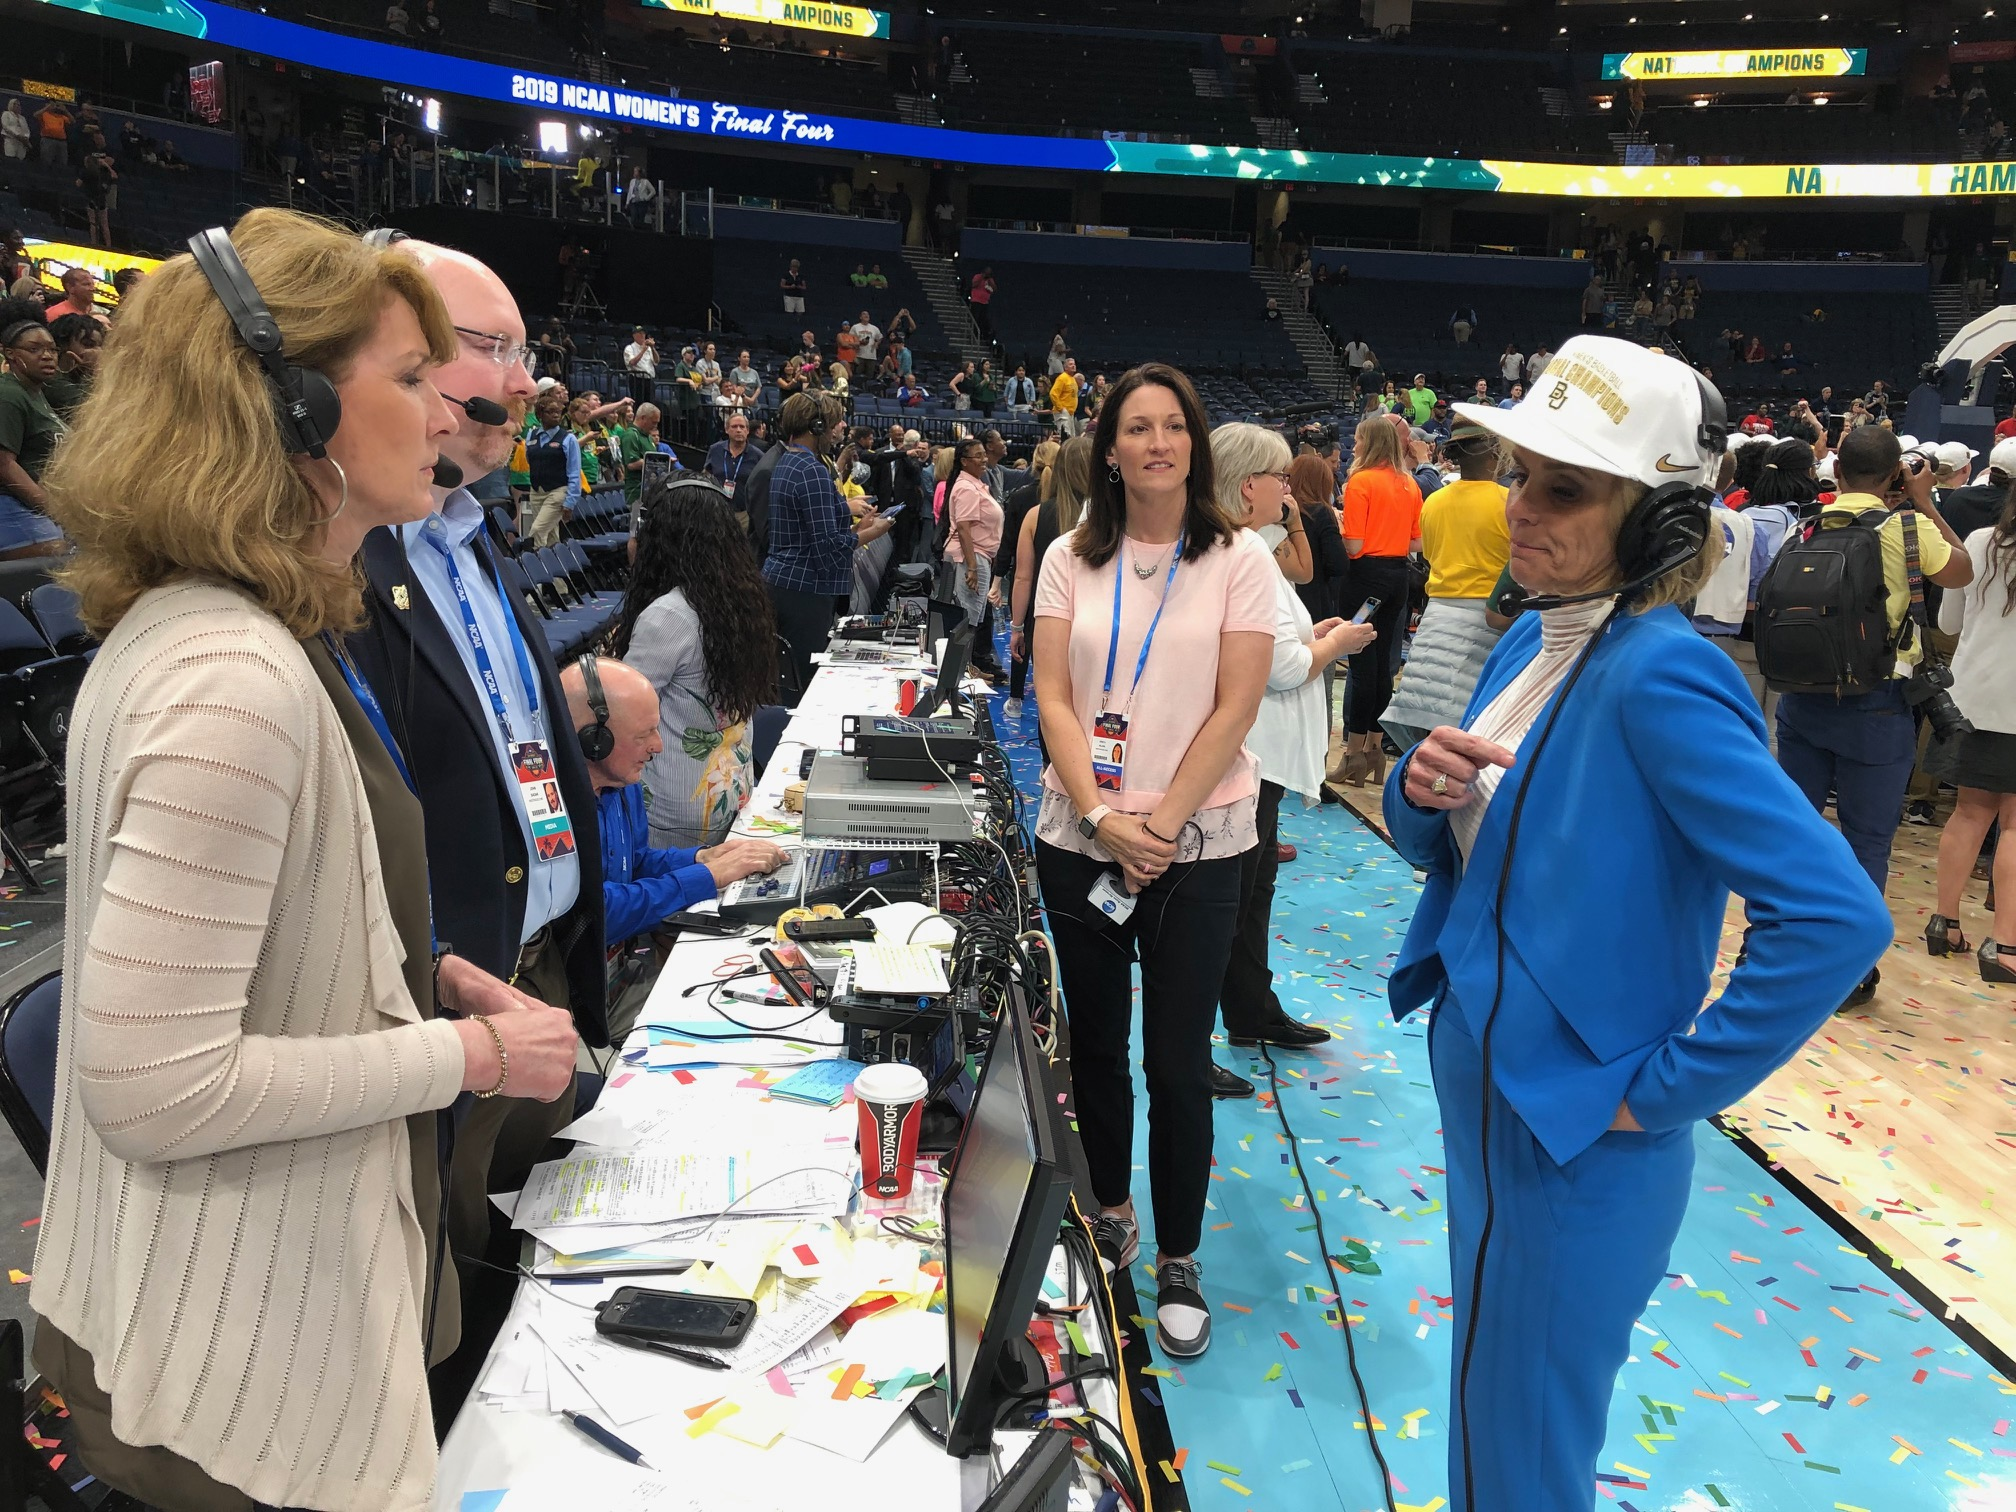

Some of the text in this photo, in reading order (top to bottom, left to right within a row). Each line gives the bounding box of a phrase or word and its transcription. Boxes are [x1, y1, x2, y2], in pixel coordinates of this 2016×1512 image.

[1747, 54, 1825, 72] AMPIONS
[512, 75, 835, 142] 2019 NCAA WOMEN'S Final Four
[1949, 164, 2016, 193] HAM
[1592, 358, 1625, 390] BASKETBALL
[1565, 363, 1630, 425] CHAMPIONS
[453, 577, 467, 602] NCAA
[468, 624, 483, 649] NCAA
[483, 670, 498, 695] NCAA
[883, 1103, 898, 1172] BODYARMOR
[878, 1185, 898, 1193] NCAA
